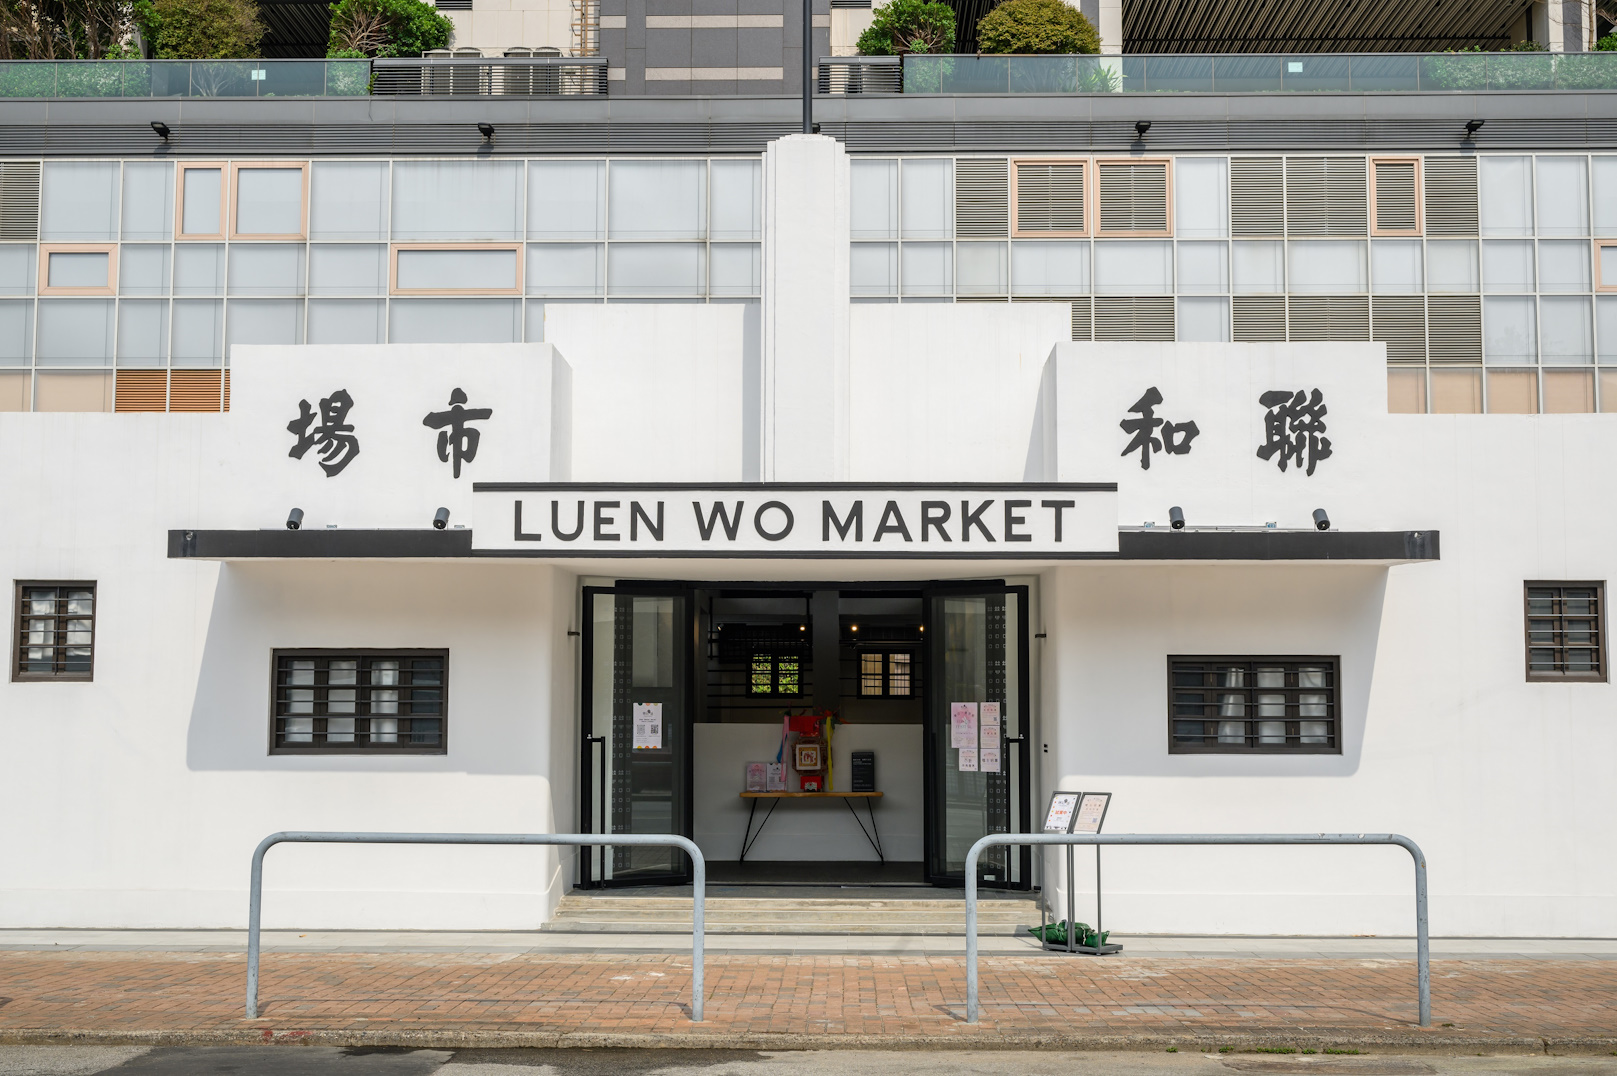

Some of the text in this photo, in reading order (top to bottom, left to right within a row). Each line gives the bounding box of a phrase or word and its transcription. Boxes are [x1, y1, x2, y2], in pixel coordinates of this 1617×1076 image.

[515, 500, 1075, 542] LUEN WO MARKET
